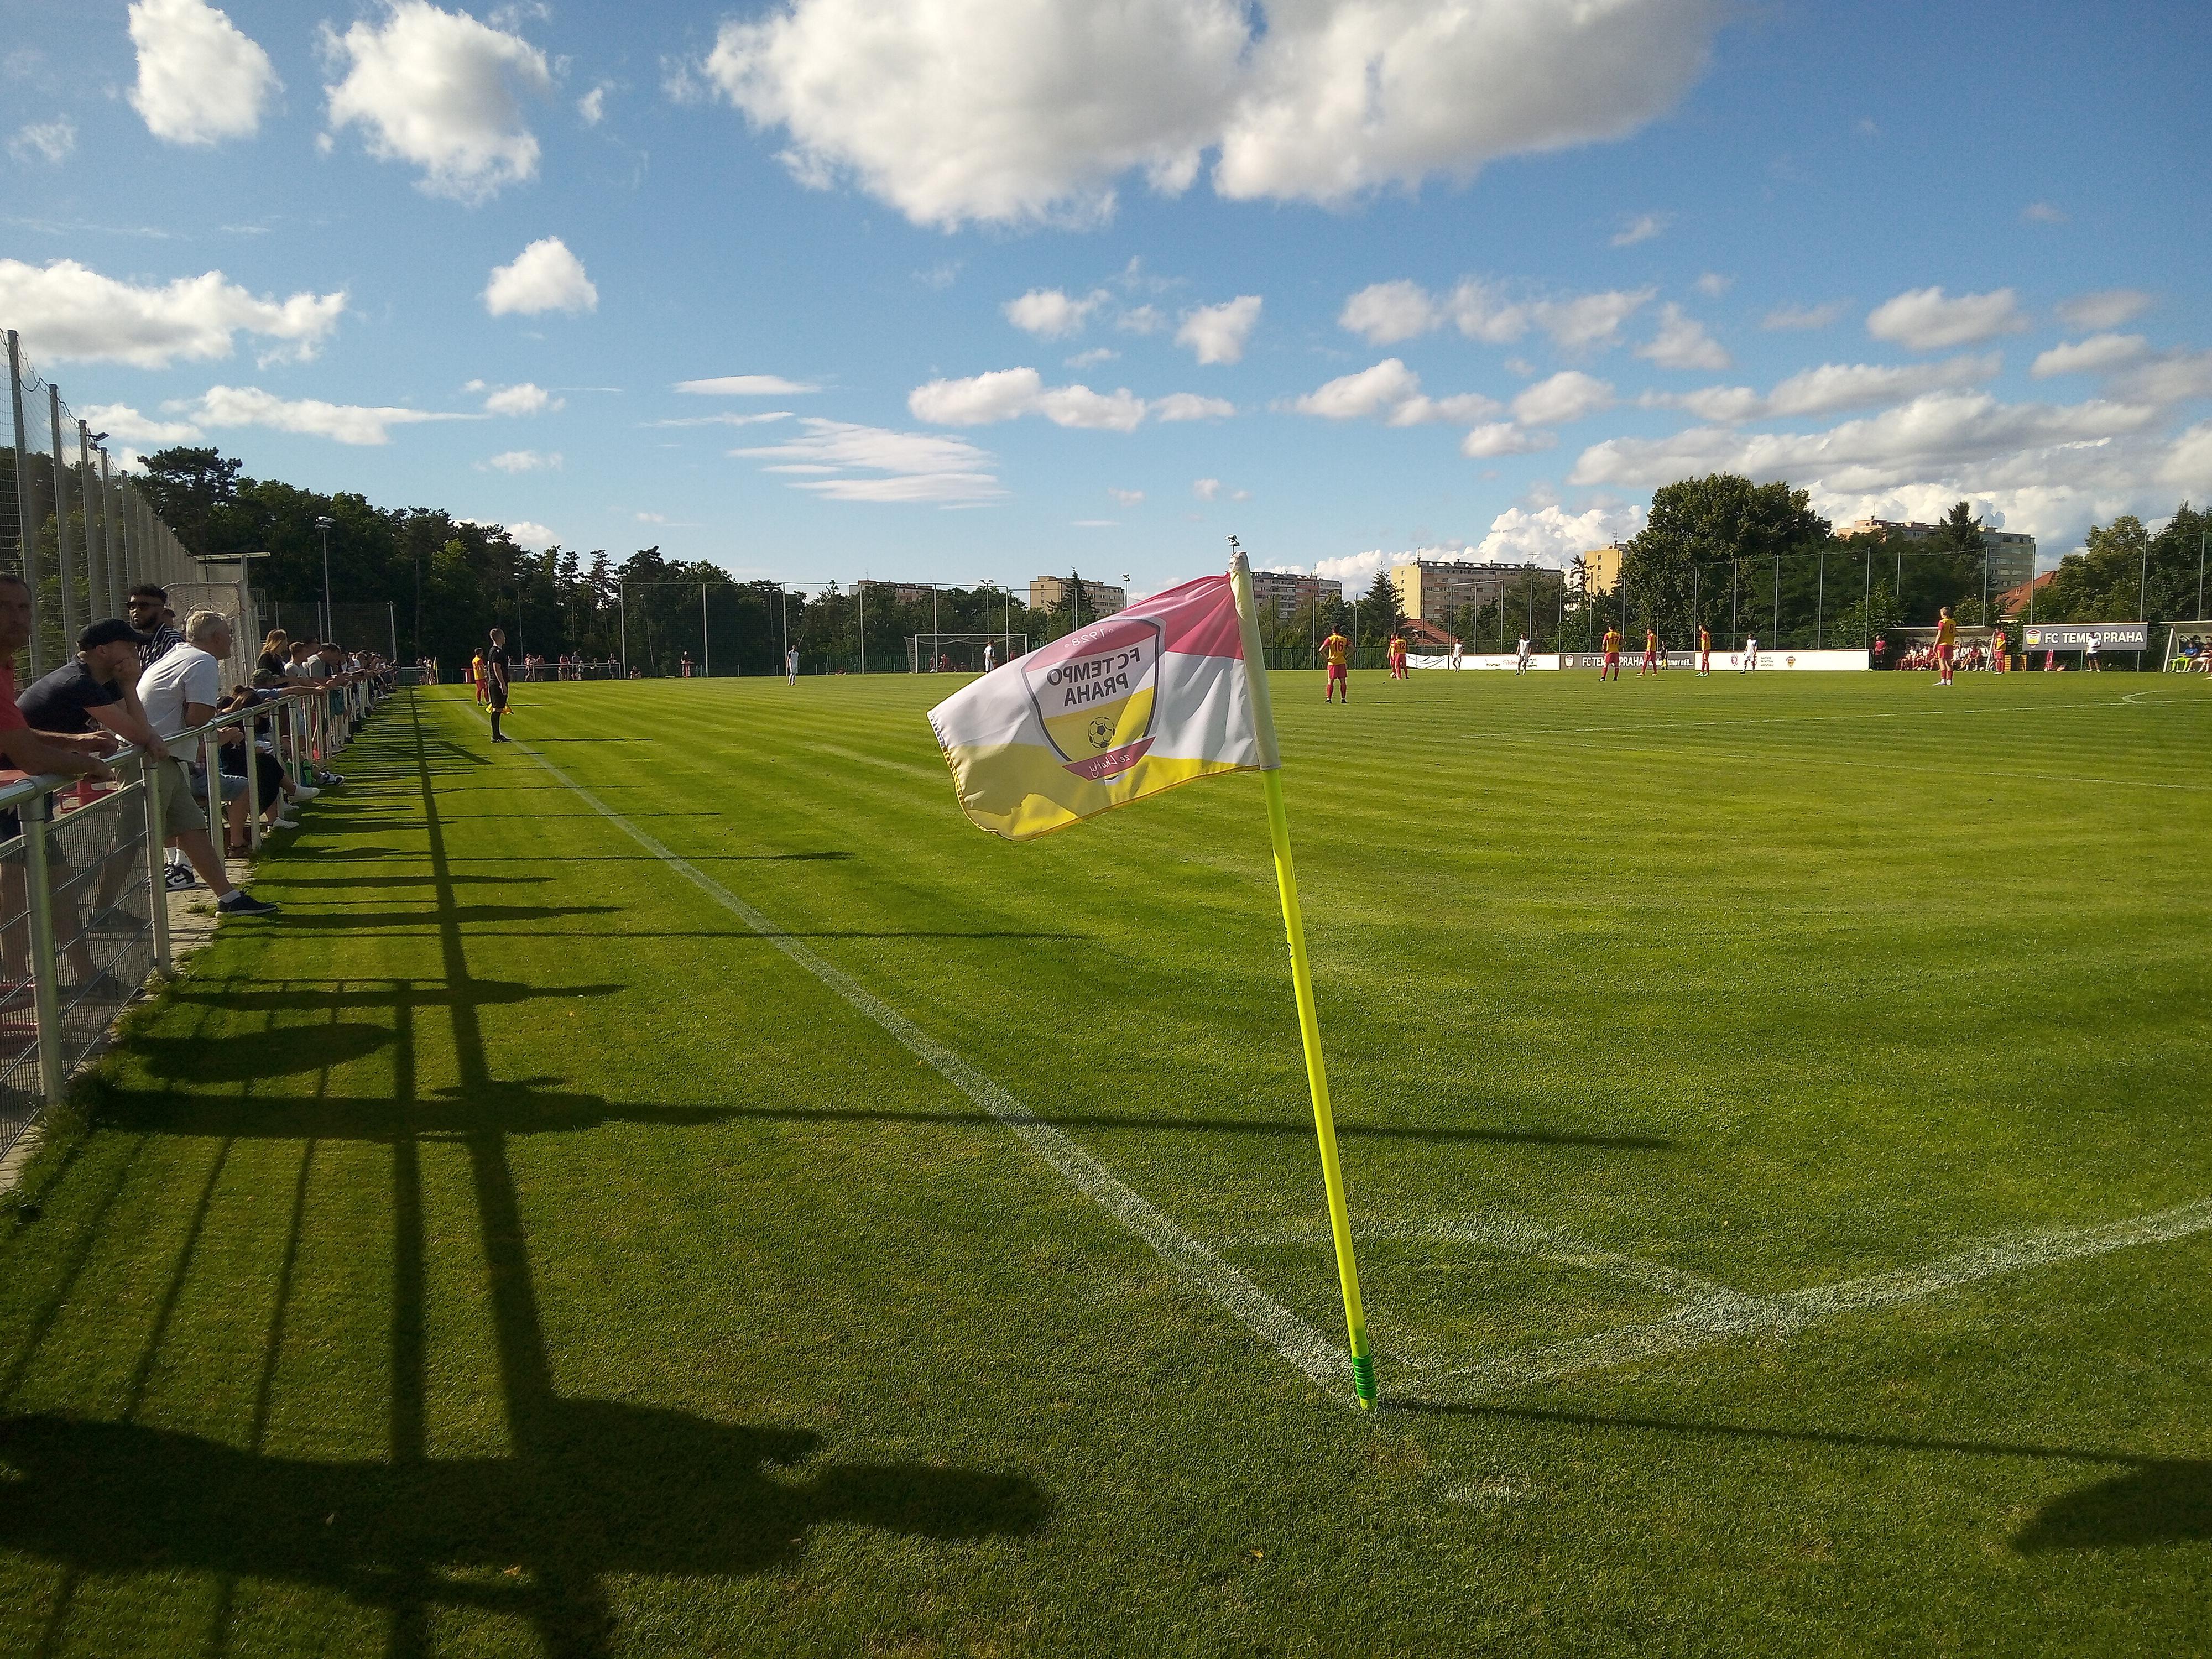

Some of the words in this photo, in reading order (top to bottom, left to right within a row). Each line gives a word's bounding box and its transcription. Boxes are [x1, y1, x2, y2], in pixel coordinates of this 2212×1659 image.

[1610, 636, 1619, 644] 17
[2044, 633, 2058, 644] FC
[2103, 631, 2143, 643] PRAHA
[1333, 640, 1344, 652] 16
[1399, 641, 1405, 650] 12
[1582, 656, 1592, 666] FC
[1619, 656, 1644, 666] PRAHA
